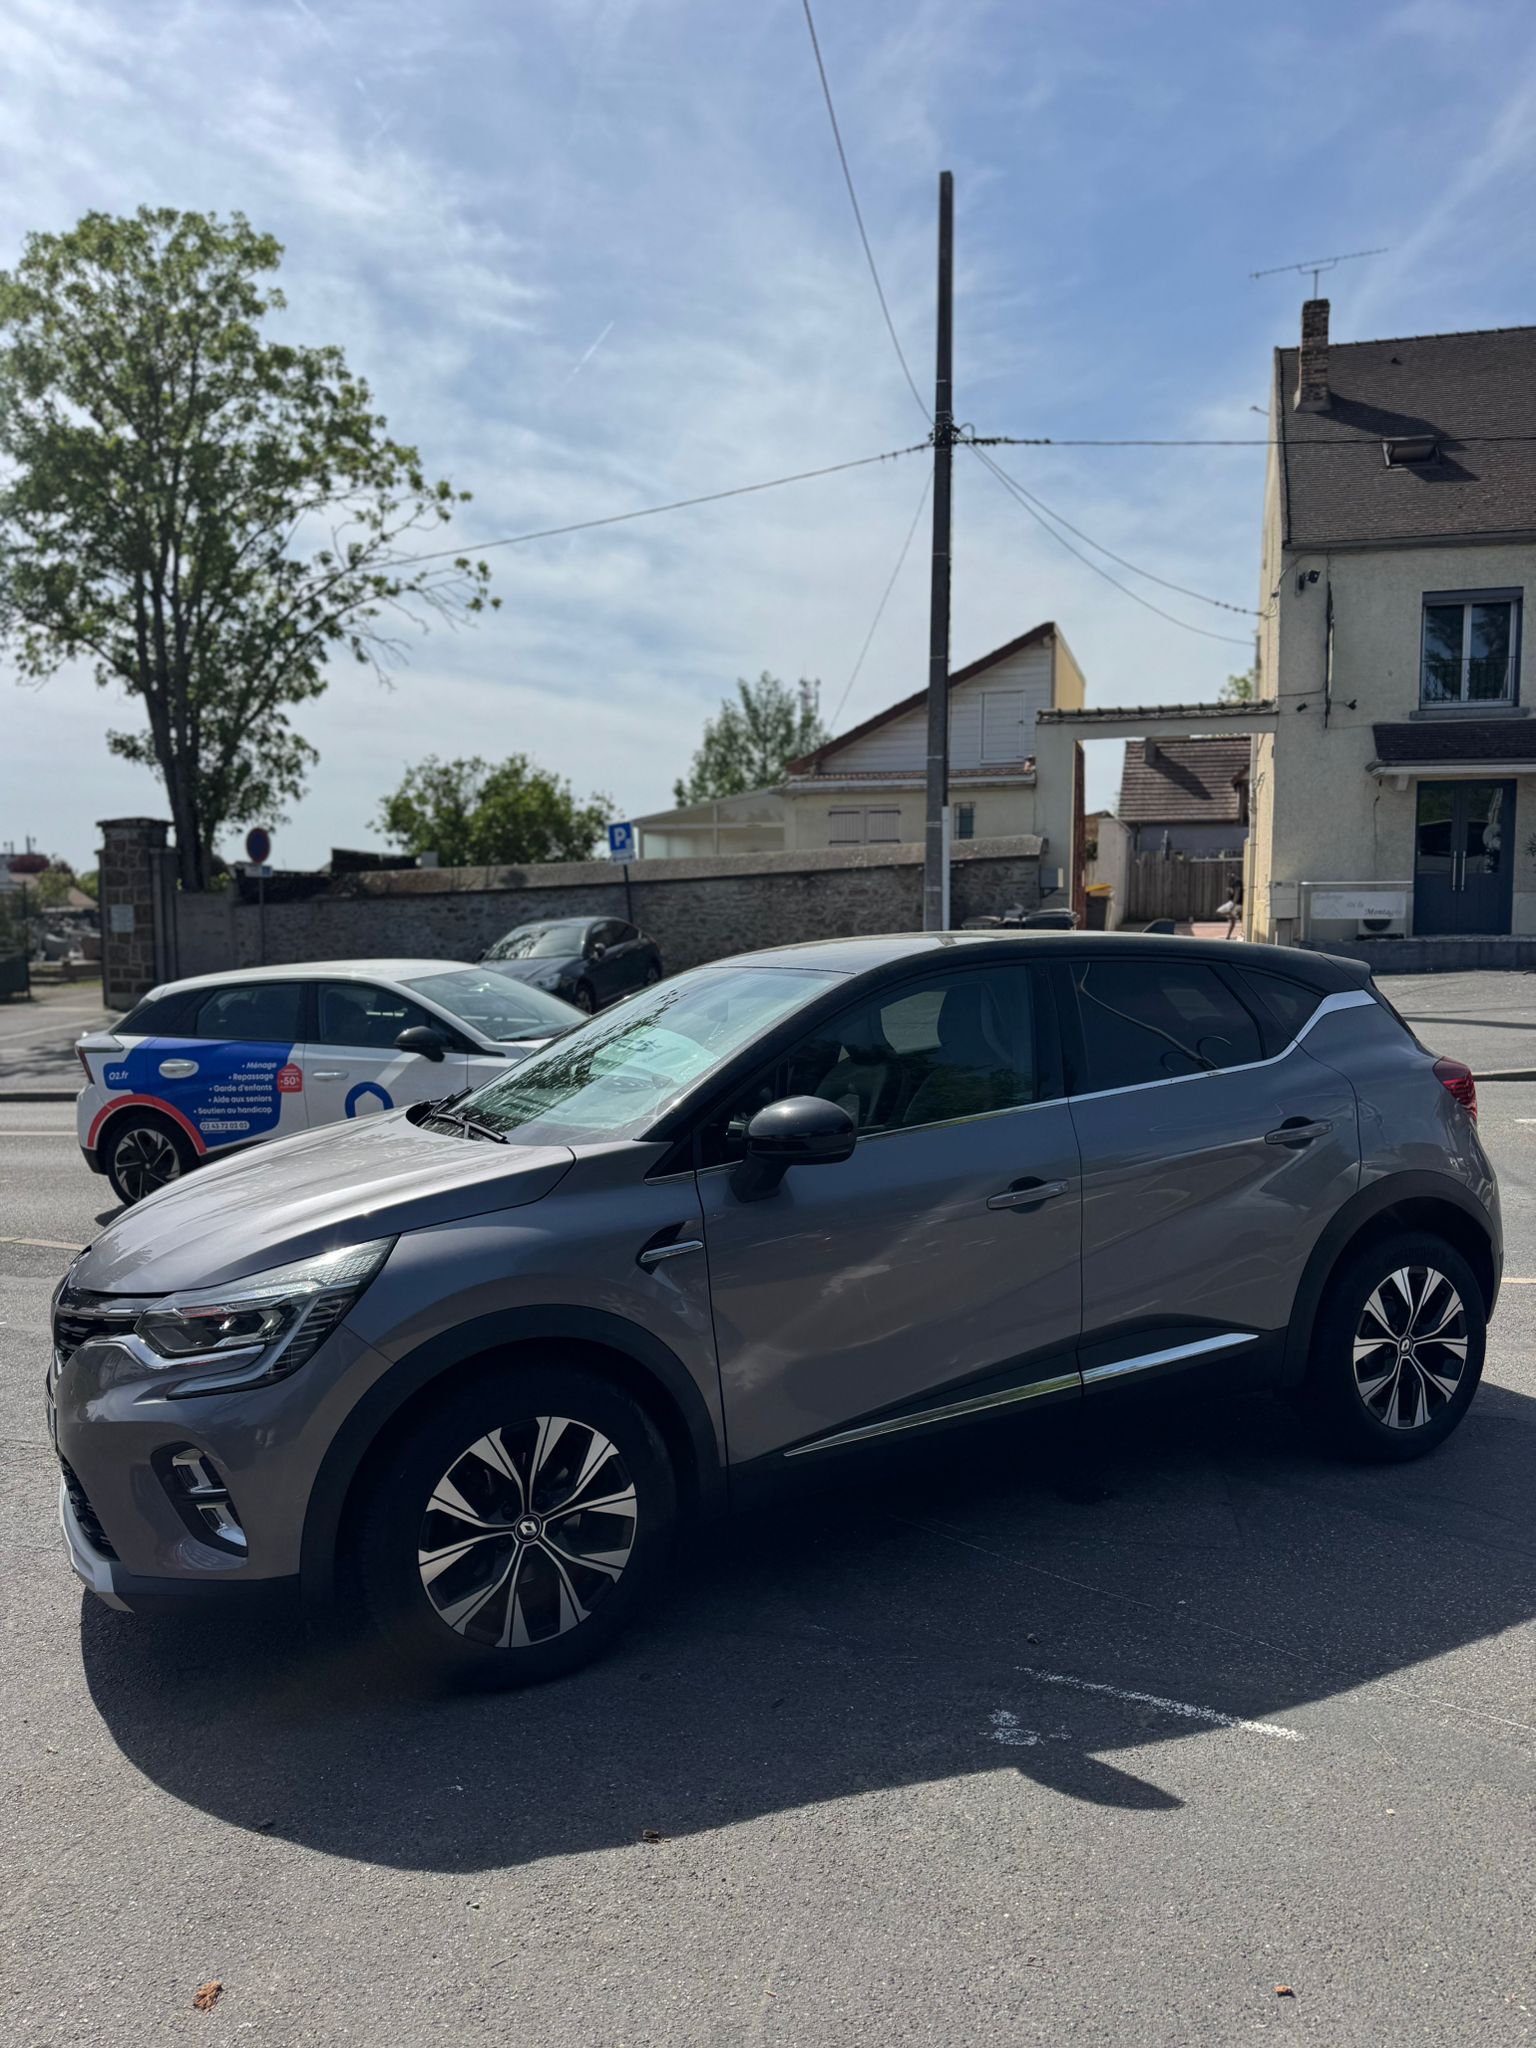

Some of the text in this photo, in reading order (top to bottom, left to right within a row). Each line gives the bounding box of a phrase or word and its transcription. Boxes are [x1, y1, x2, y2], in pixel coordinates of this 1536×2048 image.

[614, 827, 626, 847] P
[246, 1062, 277, 1070] Ménage
[232, 1073, 274, 1081] Repassage
[237, 1084, 272, 1092] d'enfants
[237, 1106, 272, 1114] handicap
